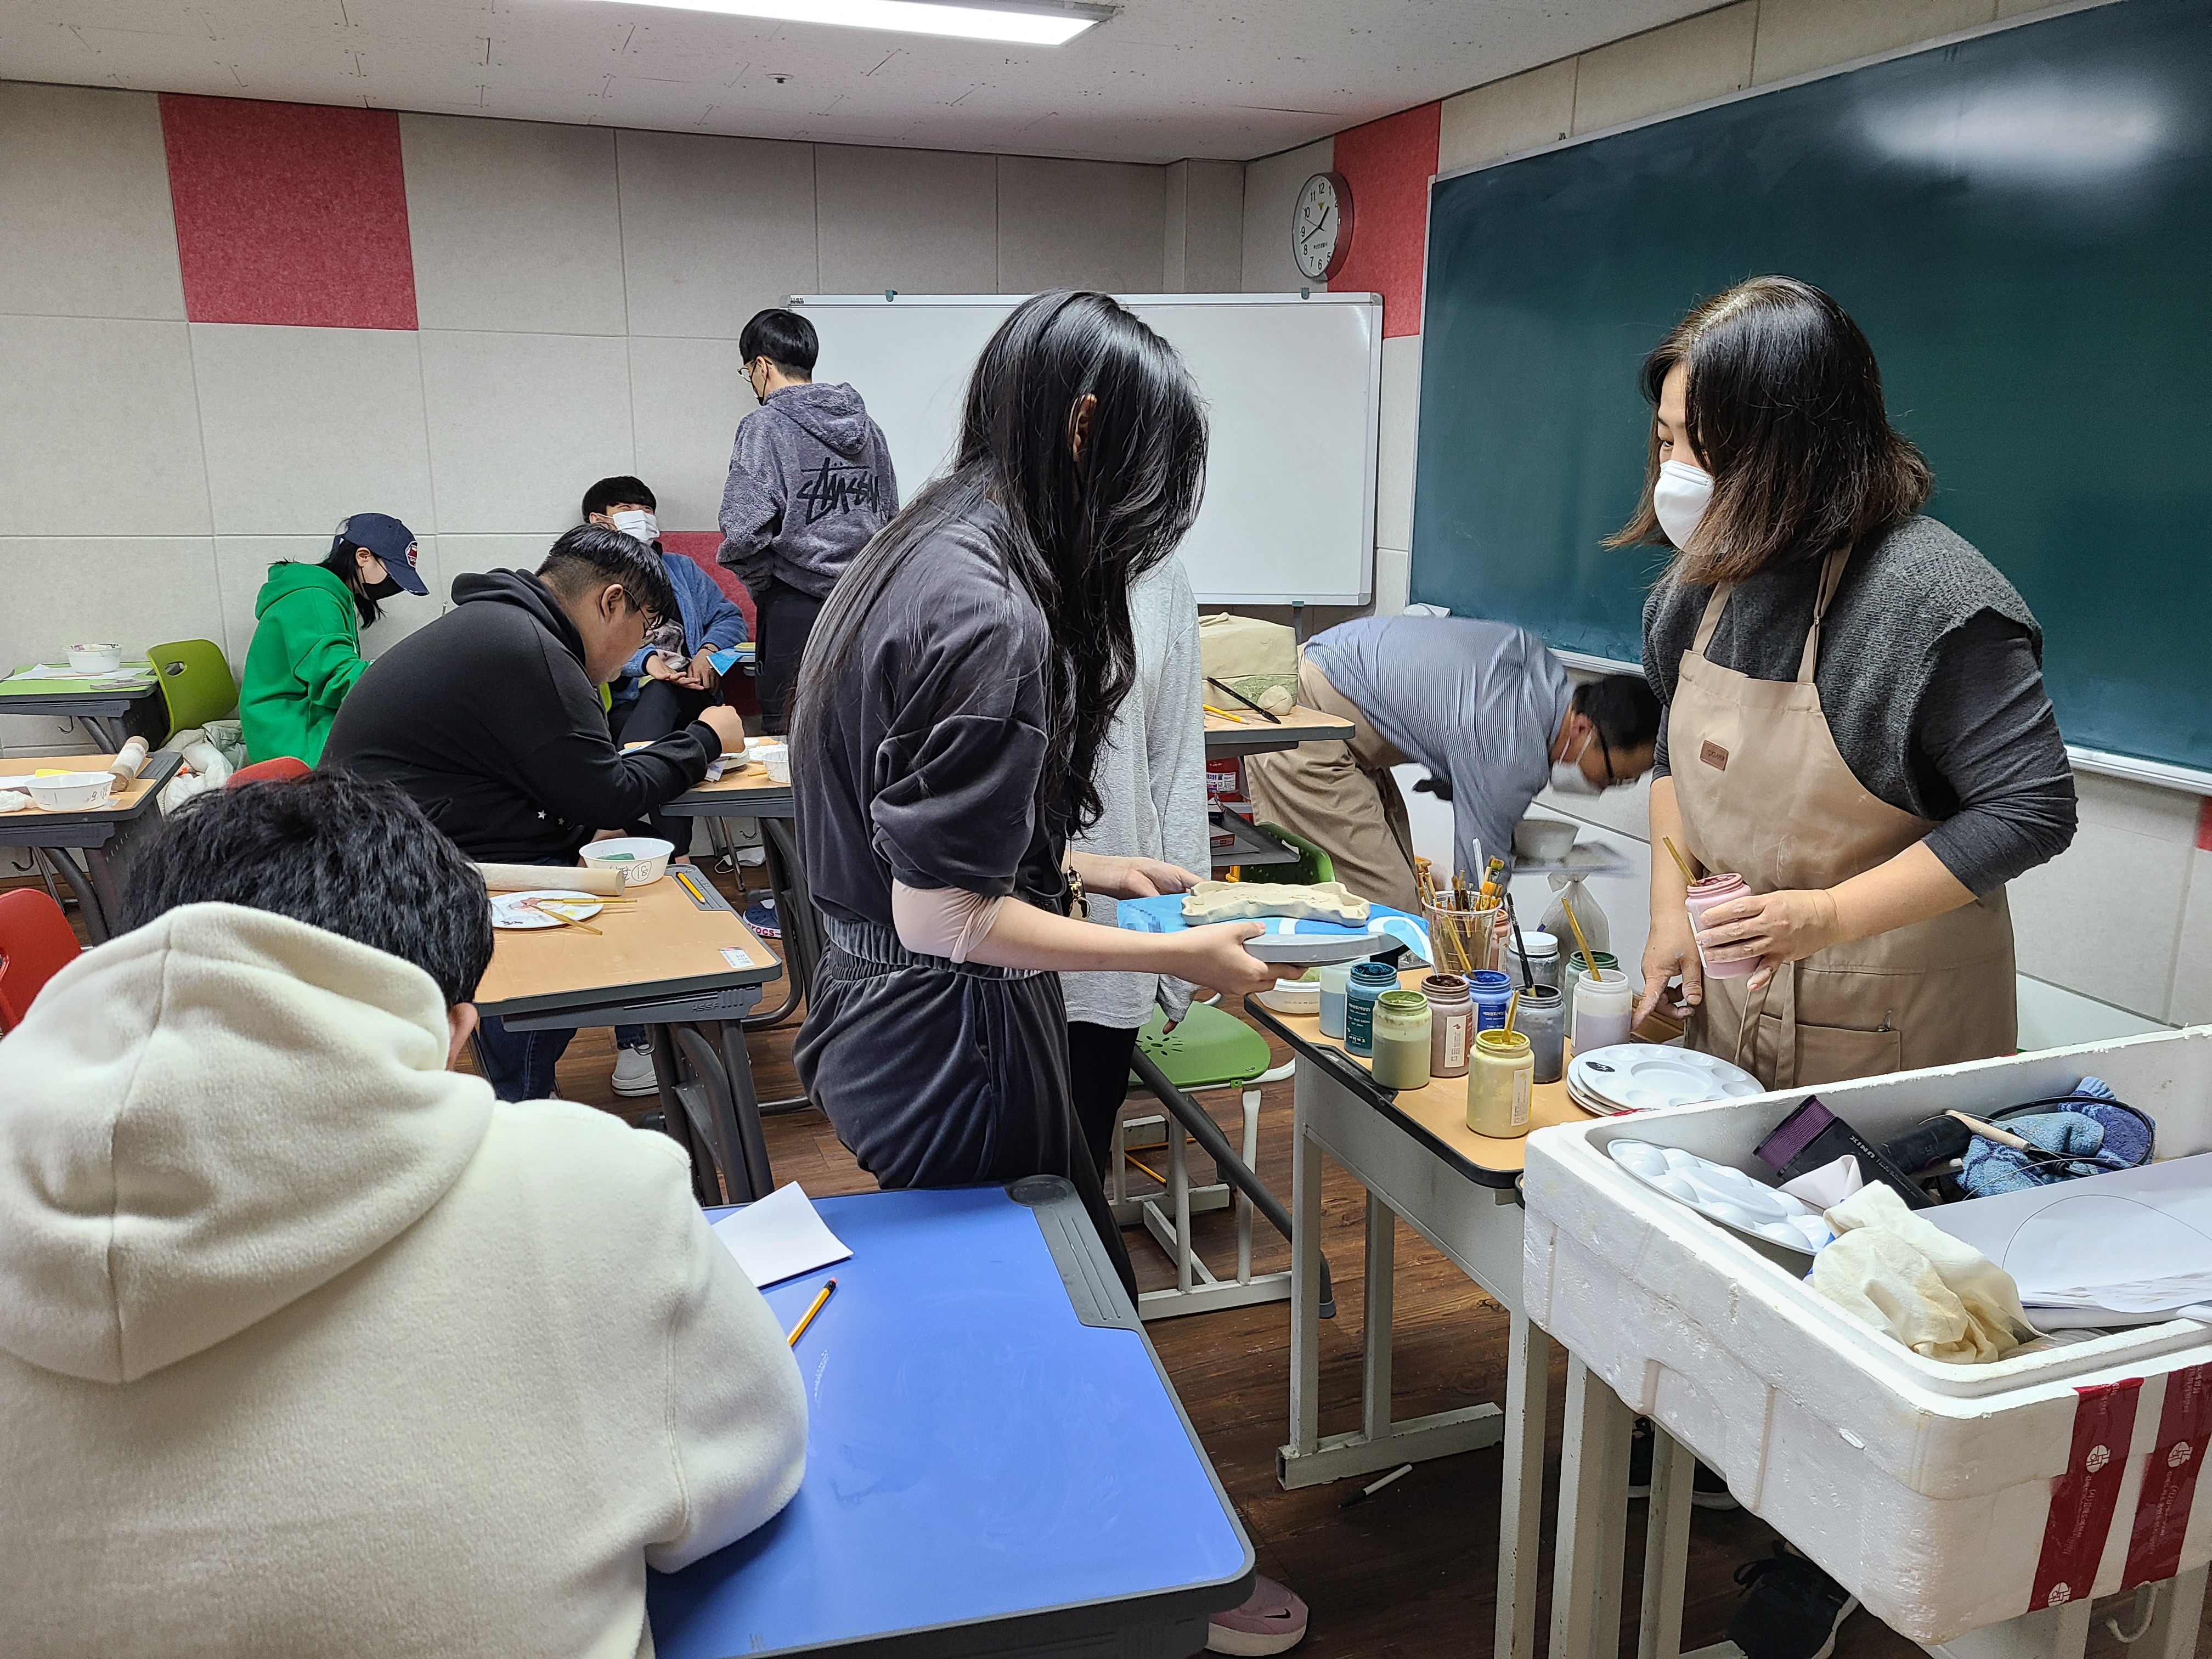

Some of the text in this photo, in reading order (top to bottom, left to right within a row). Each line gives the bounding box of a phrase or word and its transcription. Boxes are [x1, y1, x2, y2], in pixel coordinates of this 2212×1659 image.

[1318, 183, 1324, 194] 12
[1328, 185, 1331, 196] 1
[1310, 190, 1316, 202] 11
[1304, 207, 1310, 218] 10
[1301, 226, 1306, 238] 9
[1304, 244, 1308, 256] 8
[1310, 256, 1314, 268] 7
[1327, 252, 1331, 264] 5
[1318, 259, 1322, 270] 6
[1849, 1135, 1876, 1159] UNIX
